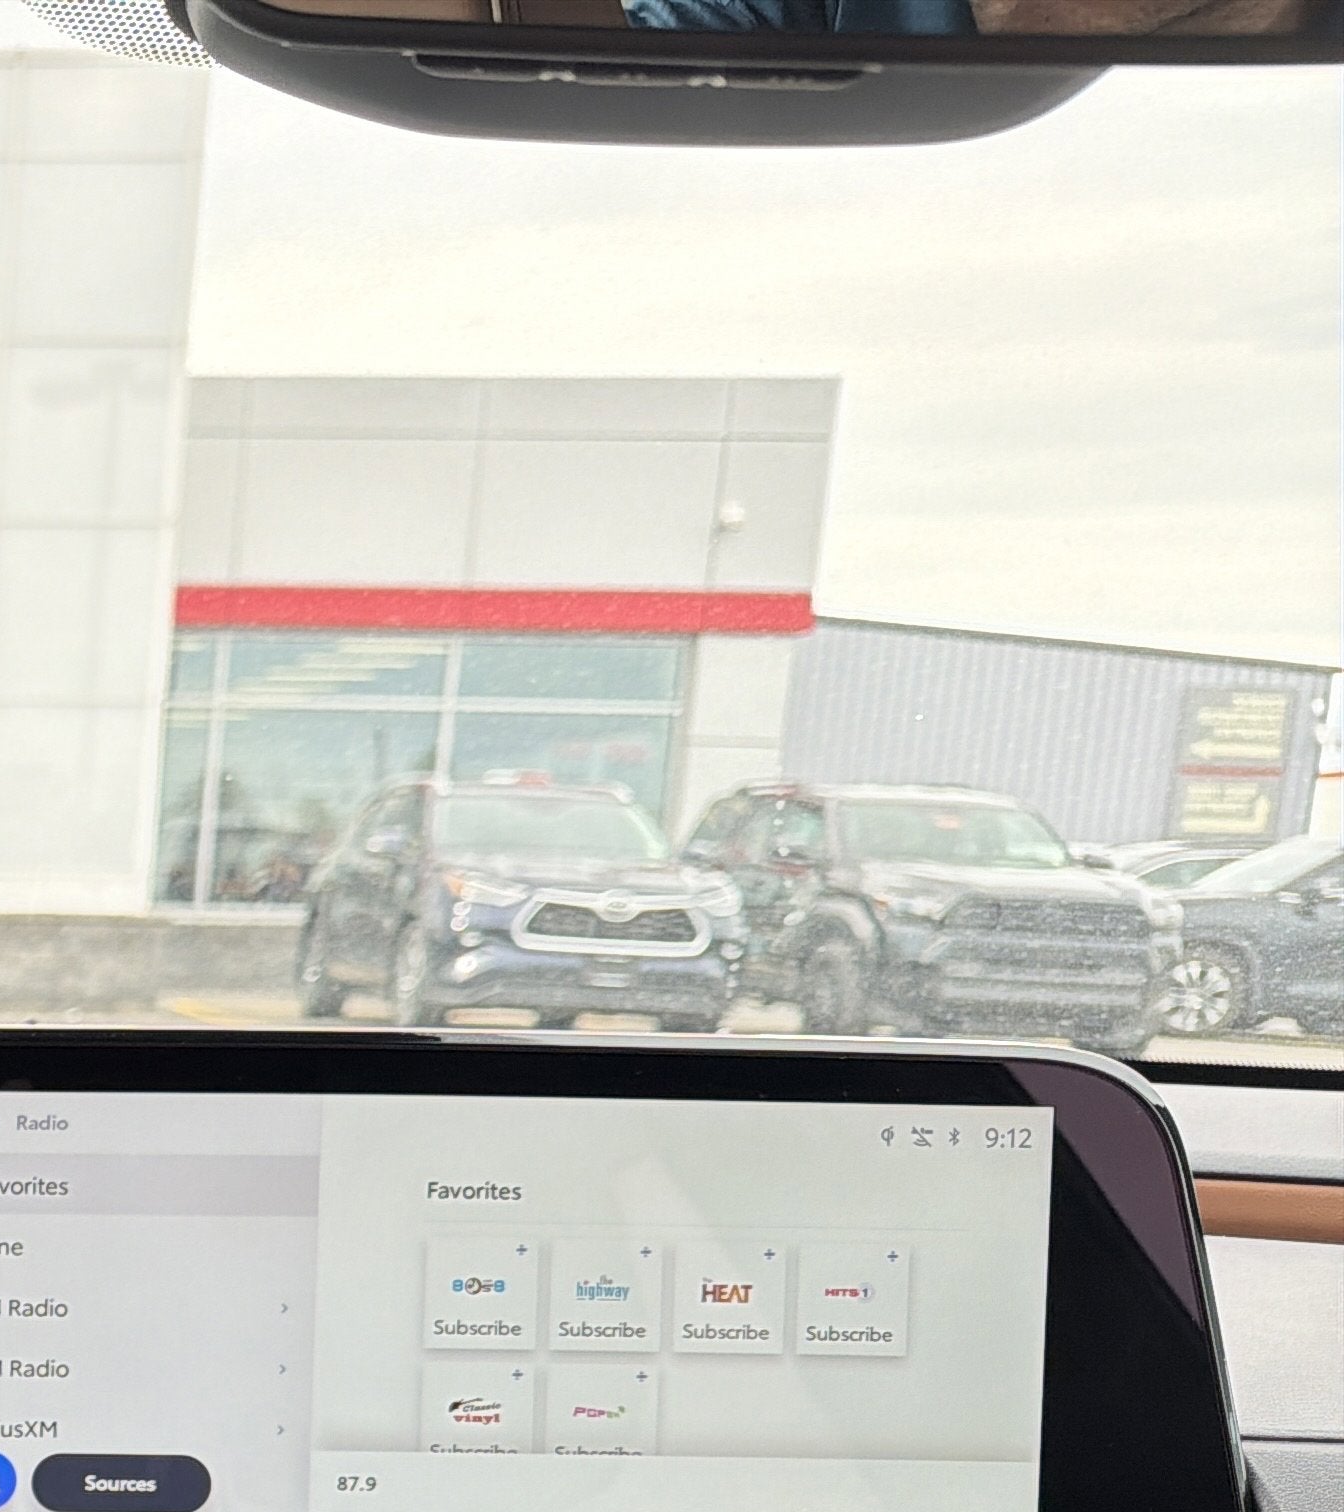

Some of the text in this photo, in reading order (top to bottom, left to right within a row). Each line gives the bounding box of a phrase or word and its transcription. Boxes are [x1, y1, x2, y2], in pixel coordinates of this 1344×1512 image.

[16, 1113, 69, 1131] Radio
[985, 1127, 1032, 1148] 9:12
[426, 1181, 522, 1201] Favorites
[576, 1280, 630, 1301] highway
[701, 1284, 753, 1303] HEAT
[825, 1288, 859, 1297] HITS
[7, 1299, 69, 1318] Radio
[433, 1319, 522, 1337] Subscribe
[558, 1321, 646, 1338] Subscribe
[682, 1323, 770, 1341] Subscribe
[806, 1325, 893, 1343] Subscribe
[9, 1360, 70, 1379] Radio
[84, 1475, 158, 1492] Sources
[336, 1475, 377, 1493] 87.9
